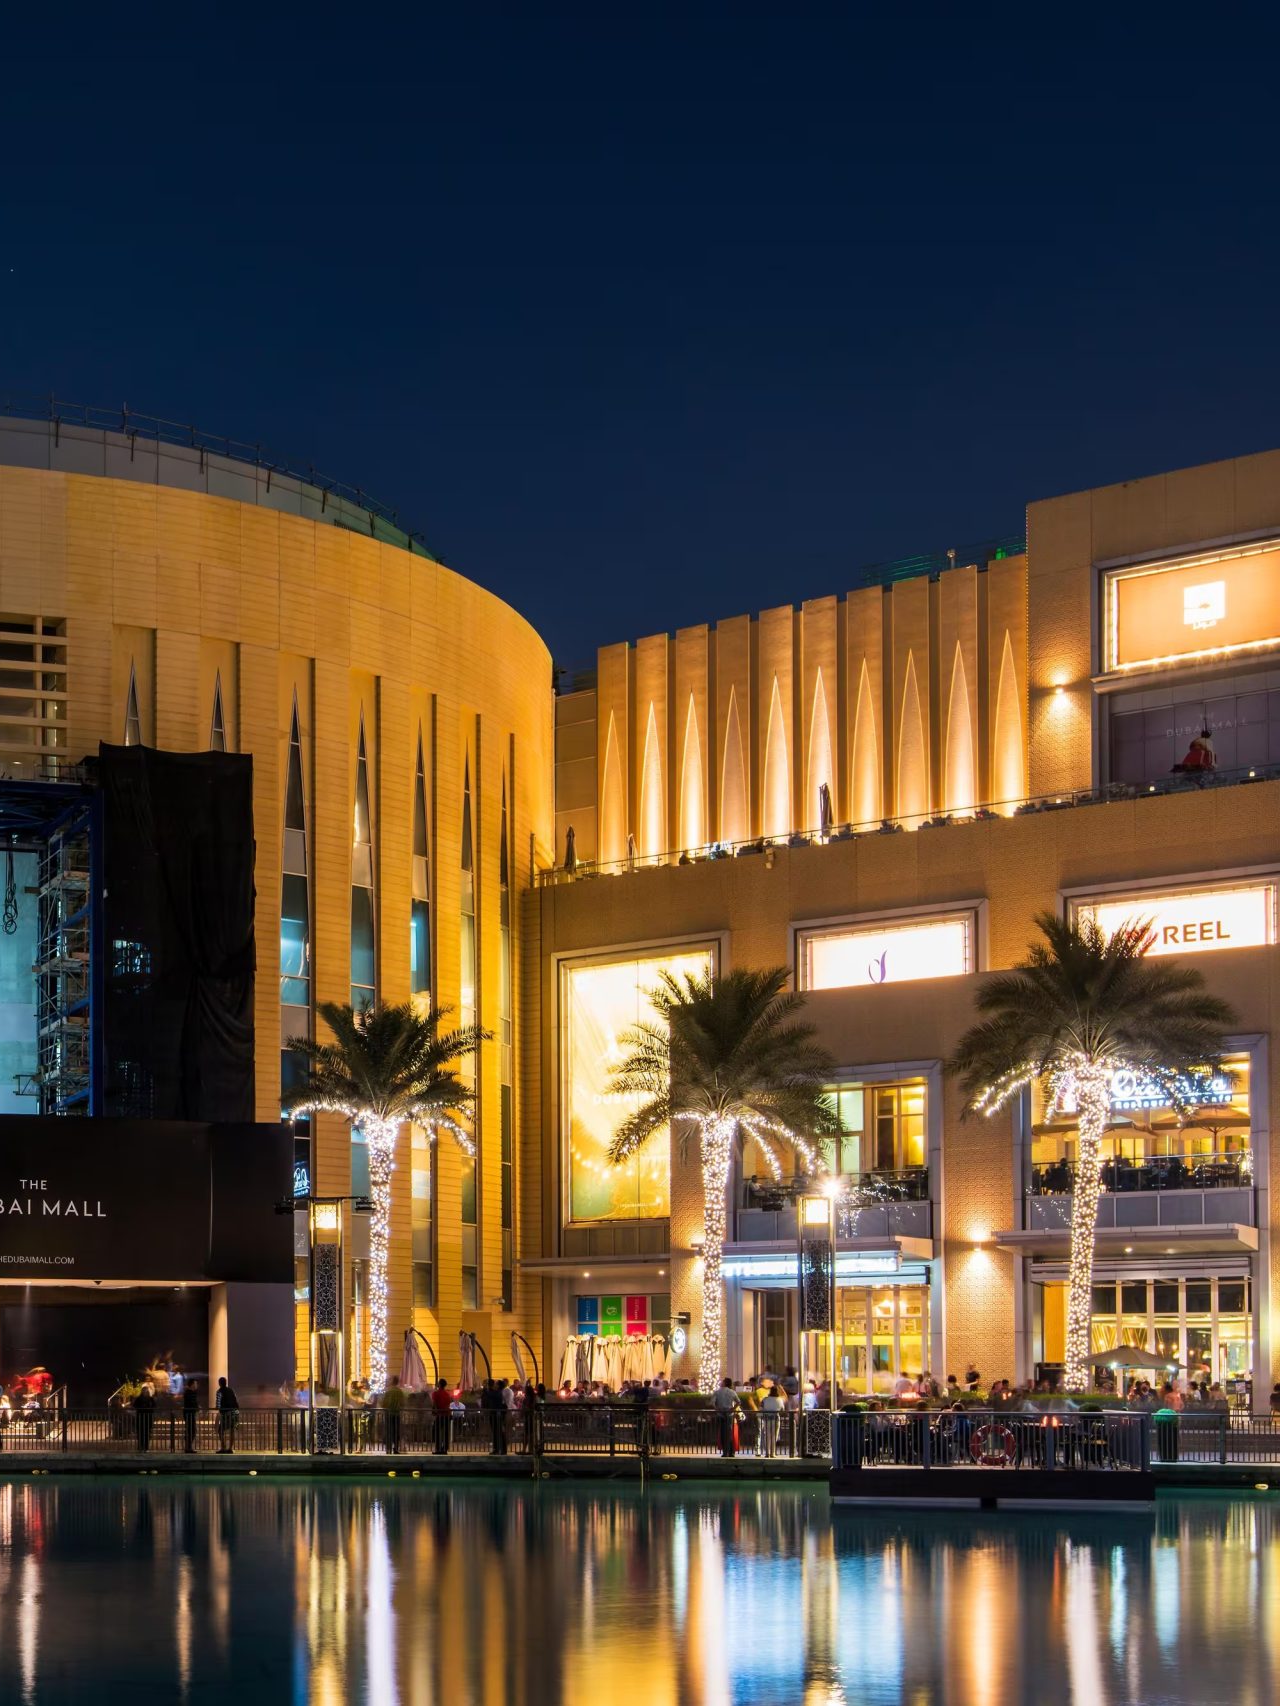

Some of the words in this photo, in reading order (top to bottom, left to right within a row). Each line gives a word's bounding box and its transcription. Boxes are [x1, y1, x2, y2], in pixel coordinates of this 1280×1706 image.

[1163, 920, 1231, 945] REEL
[20, 1179, 48, 1190] THE
[43, 1199, 107, 1217] MALL
